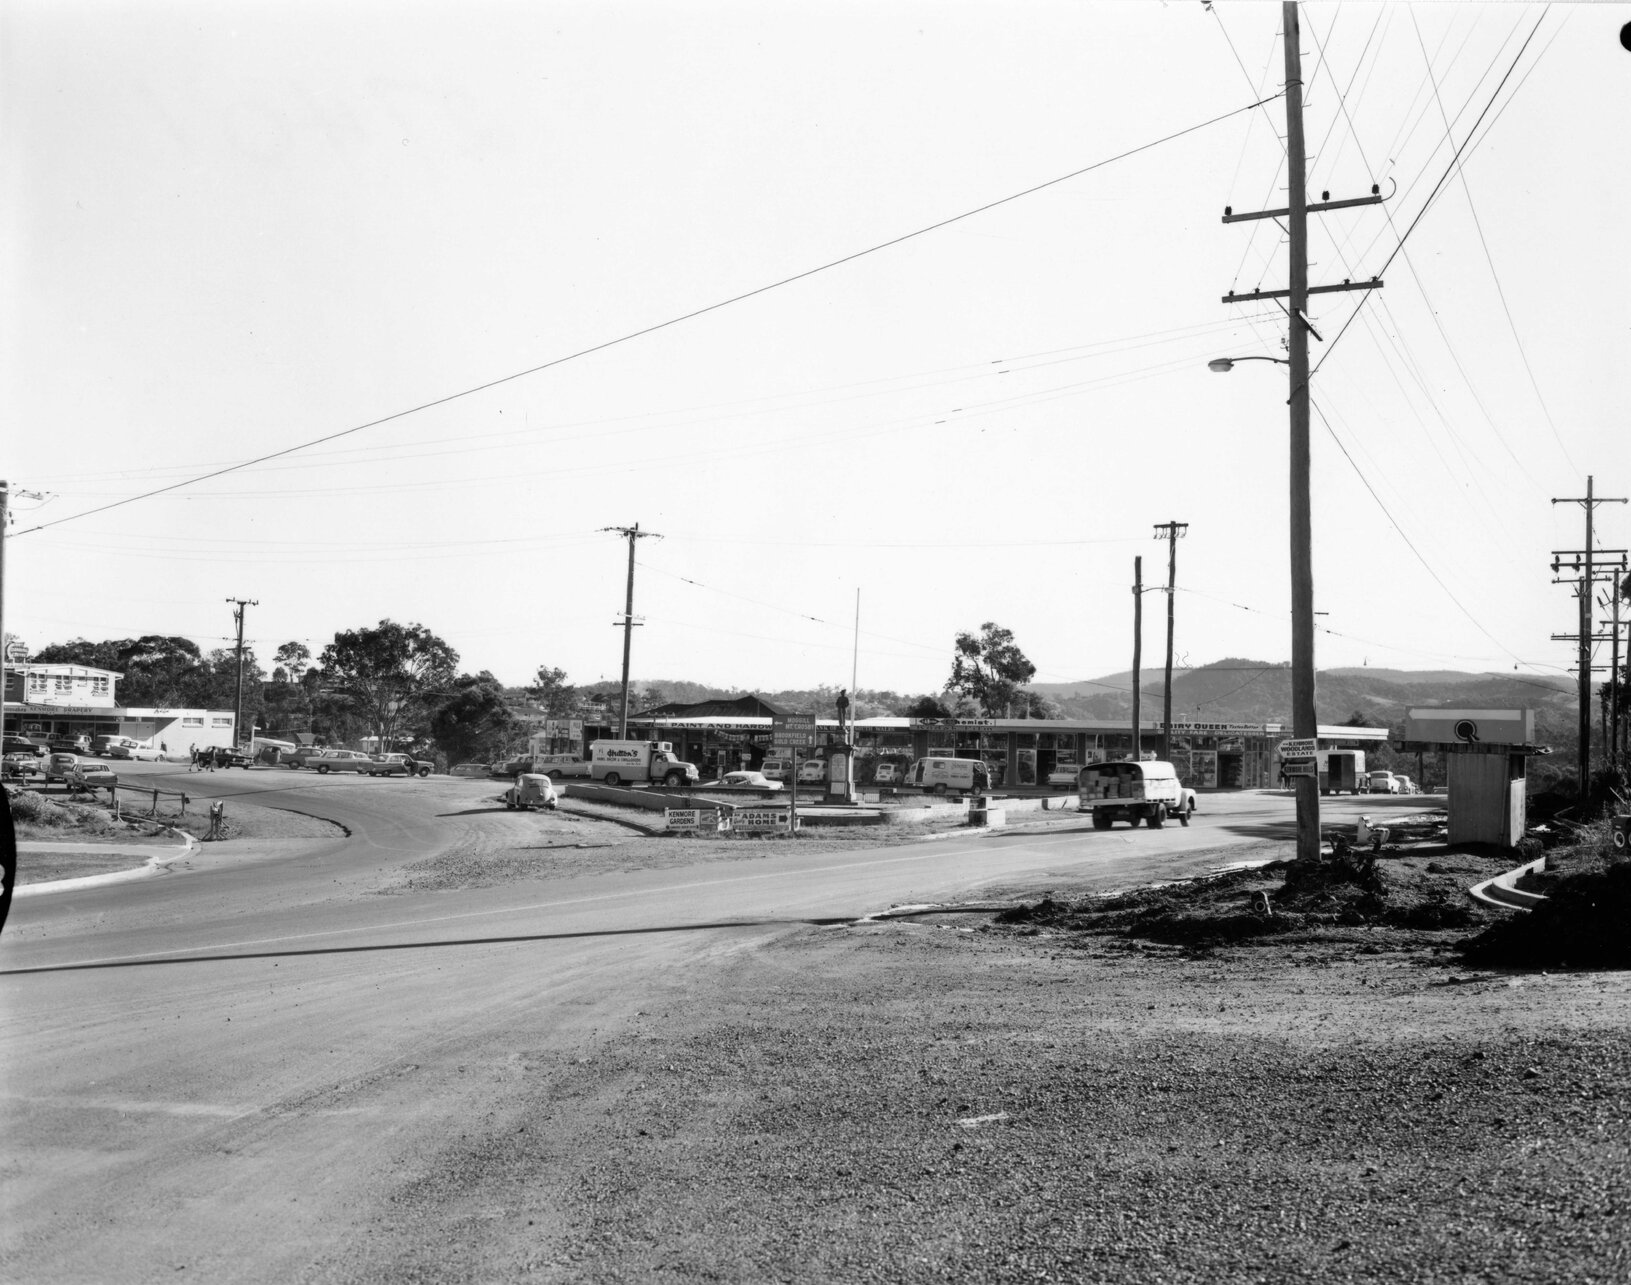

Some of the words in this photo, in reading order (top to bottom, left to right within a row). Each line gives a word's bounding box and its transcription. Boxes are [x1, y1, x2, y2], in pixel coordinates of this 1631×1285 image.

[1194, 722, 1228, 730] QUEEN
[668, 810, 696, 818] KENMORE
[669, 817, 695, 825] GARDENS
